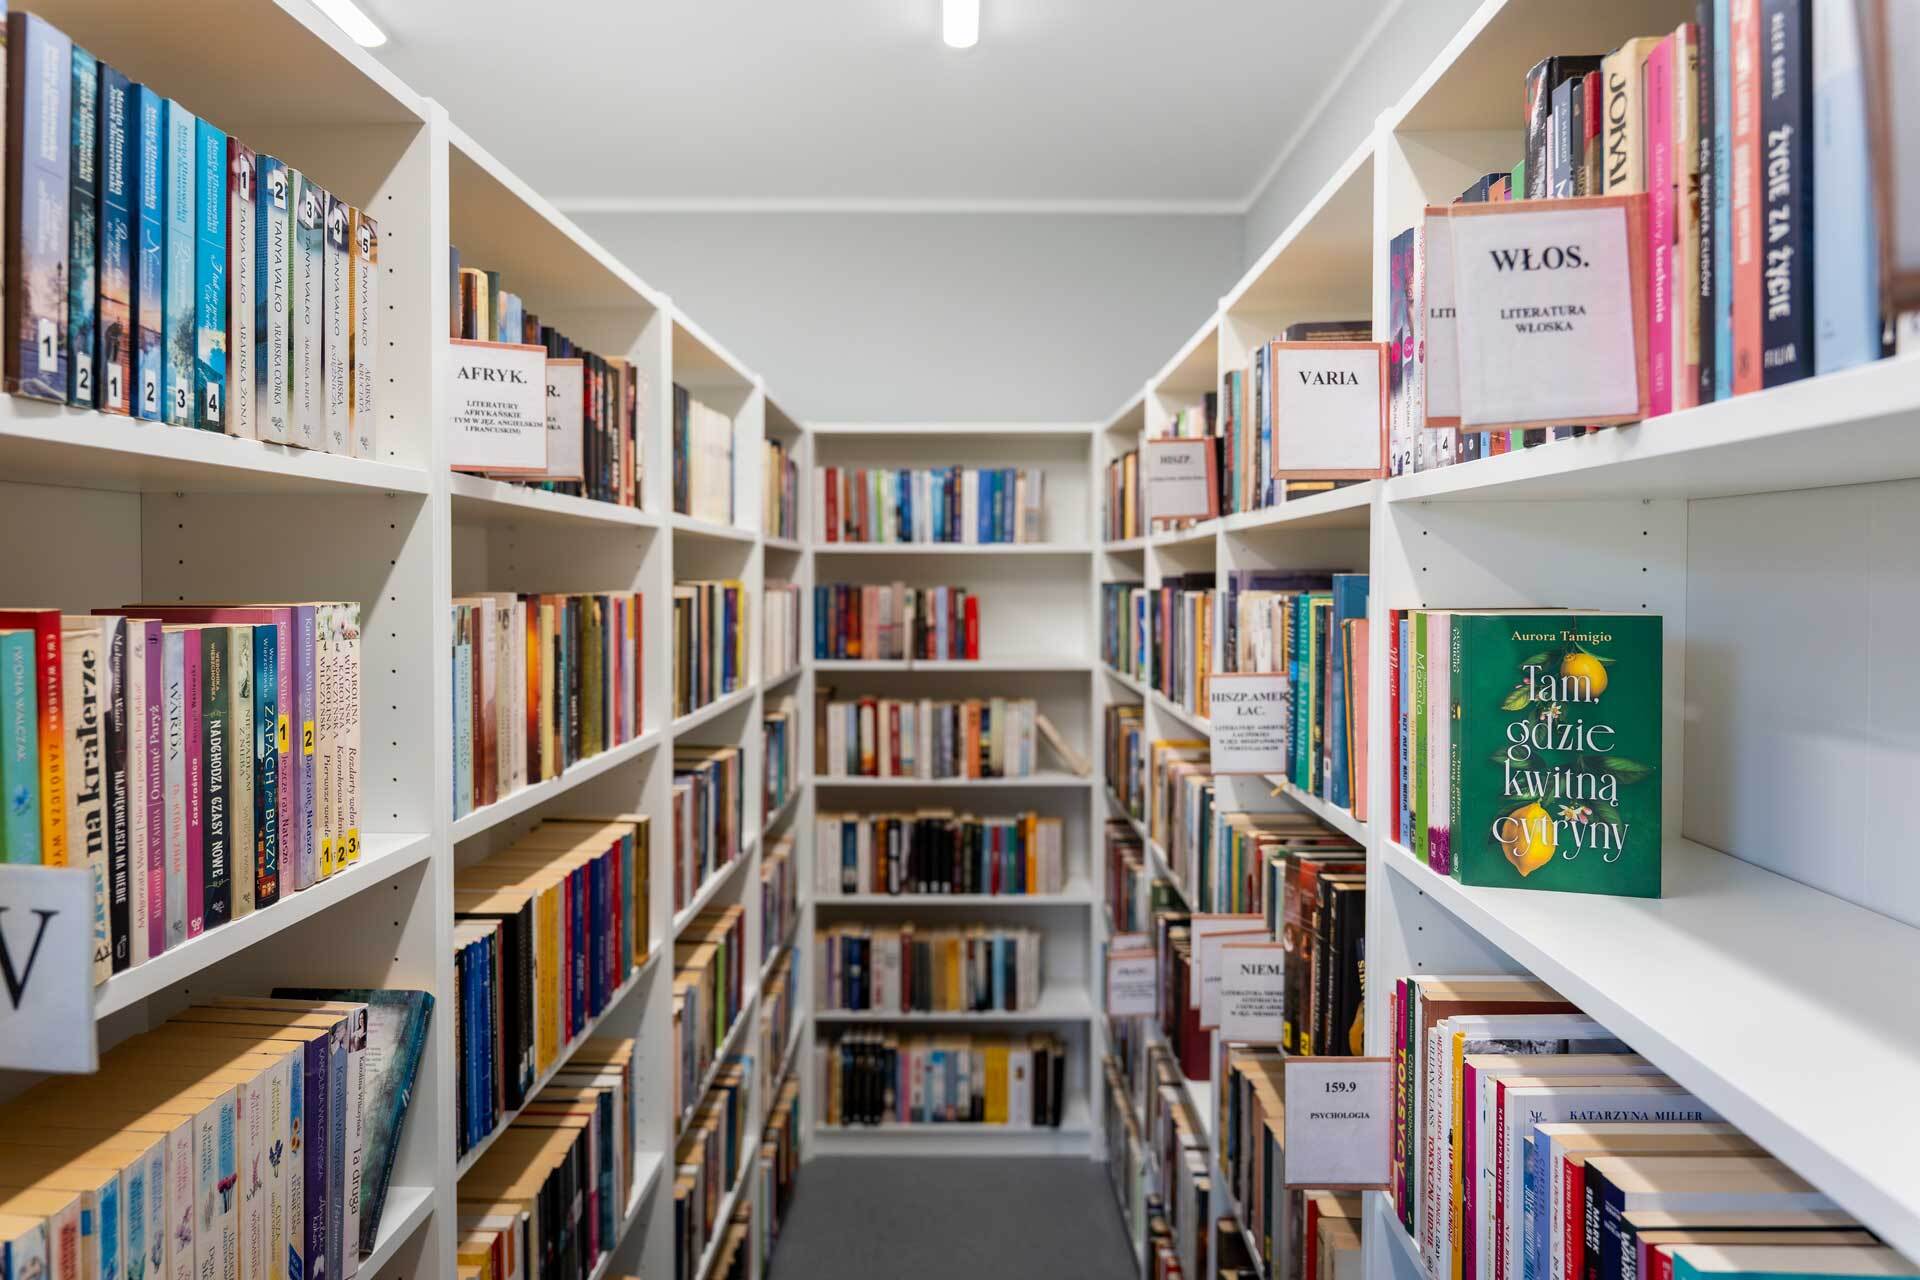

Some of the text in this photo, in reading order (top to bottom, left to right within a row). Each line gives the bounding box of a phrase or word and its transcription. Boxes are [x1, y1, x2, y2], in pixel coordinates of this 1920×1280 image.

[242, 170, 247, 189] 1
[1768, 123, 1794, 202] ŻYCIE
[274, 181, 283, 200] 2
[307, 201, 313, 218] 3
[1768, 205, 1791, 243] ZA
[334, 219, 341, 236] 4
[362, 237, 369, 254] 5
[1489, 245, 1590, 272] WŁOS.
[1655, 244, 1667, 324] kochanie
[1766, 245, 1794, 321] ŻYCIE
[273, 219, 283, 406] TANYA VALKO ARABSKA CÓRKA
[1500, 304, 1588, 320] LITERATURA
[1515, 321, 1574, 334] WŁOSKA
[43, 335, 51, 358] 1
[333, 294, 341, 337] VALKO
[337, 358, 345, 406] ARABSKA
[79, 368, 88, 390] 2
[110, 377, 118, 398] 1
[146, 381, 154, 402] 2
[457, 365, 528, 385] AFRYK.
[1298, 371, 1360, 386] VARIA
[177, 389, 186, 409] 3
[208, 394, 217, 413] 4
[464, 409, 522, 419] AFRYKAŃSKIE
[466, 399, 519, 410] LITERATURY
[1391, 453, 1397, 467] 1
[1404, 451, 1411, 466] 2
[1442, 435, 1449, 451] 4
[46, 633, 57, 662] EWA
[280, 621, 288, 671] Karolina
[1511, 630, 1612, 645] Aurora Tamigio
[1297, 602, 1309, 760] ISABEL ALLENDE
[1415, 652, 1425, 716] Moccia
[1522, 664, 1600, 705] Tam,
[76, 649, 101, 806] kraterze
[113, 698, 125, 733] Warda
[149, 703, 161, 744] Paryż
[170, 682, 179, 762] WARDA
[279, 723, 286, 741] 1
[264, 704, 275, 786] ZAPACH
[304, 730, 313, 747] 2
[1506, 713, 1616, 762] gdzie
[150, 748, 161, 800] Ominąć
[336, 745, 344, 804] Koronkowa
[348, 747, 357, 826] Rozdarty welon
[1503, 758, 1618, 807] kwitną
[113, 770, 126, 853] NAJPIĘKNIEJSZA
[209, 719, 224, 878] NADCHODZĄ CZASY NOWE
[323, 754, 331, 838] Pierwsze wesele
[85, 808, 103, 857] na
[264, 808, 276, 871] BURZY
[280, 818, 289, 864] Nataszo
[304, 811, 313, 855] Nataszo
[348, 837, 356, 853] 3
[1492, 814, 1630, 863] cytryny
[115, 854, 126, 867] NA
[323, 847, 329, 863] 1
[337, 846, 345, 863] 2
[115, 868, 126, 905] NIEBIE
[1240, 964, 1285, 976] NIEM.
[1428, 1038, 1436, 1084] LILLIAN
[335, 1066, 344, 1120] Karolina
[1324, 1081, 1357, 1093] 159.9
[1309, 1111, 1370, 1120] PSYCHOLOGIA
[1396, 1047, 1407, 1177] TOKSYCY
[1570, 1110, 1703, 1121] KATARZYNA MILLER
[353, 1143, 362, 1165] Ta
[1427, 1135, 1435, 1202] TOKSYCZNI
[348, 1169, 361, 1216] druga
[1586, 1186, 1594, 1249] SEKIELSKI
[1592, 1206, 1600, 1257] MAREK
[1434, 1234, 1442, 1262] GRAY
